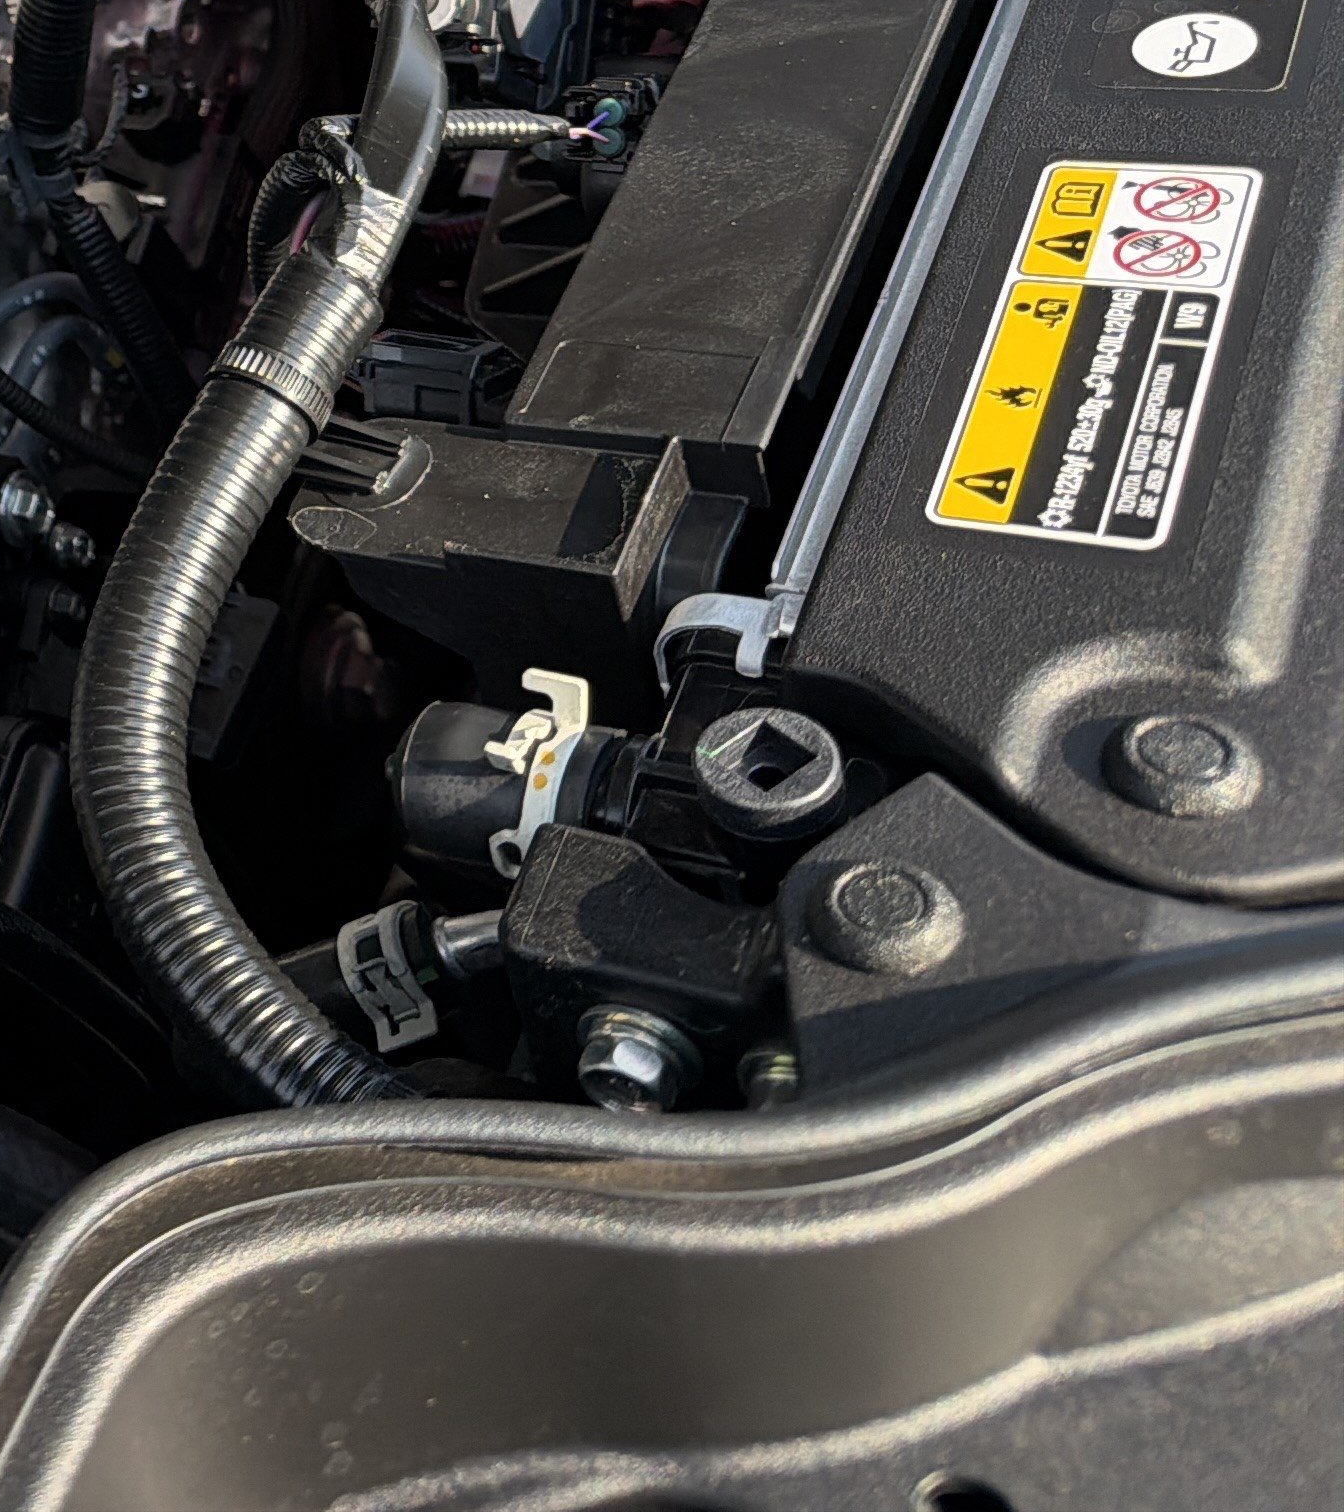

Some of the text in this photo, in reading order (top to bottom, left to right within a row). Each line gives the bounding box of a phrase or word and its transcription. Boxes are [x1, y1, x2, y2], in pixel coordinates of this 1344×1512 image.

[1174, 302, 1207, 330] W9
[1066, 397, 1114, 452] 520±30g
[1115, 362, 1175, 514] TOYOTA MOTOR CORPORATION
[1137, 494, 1159, 519] SAE
